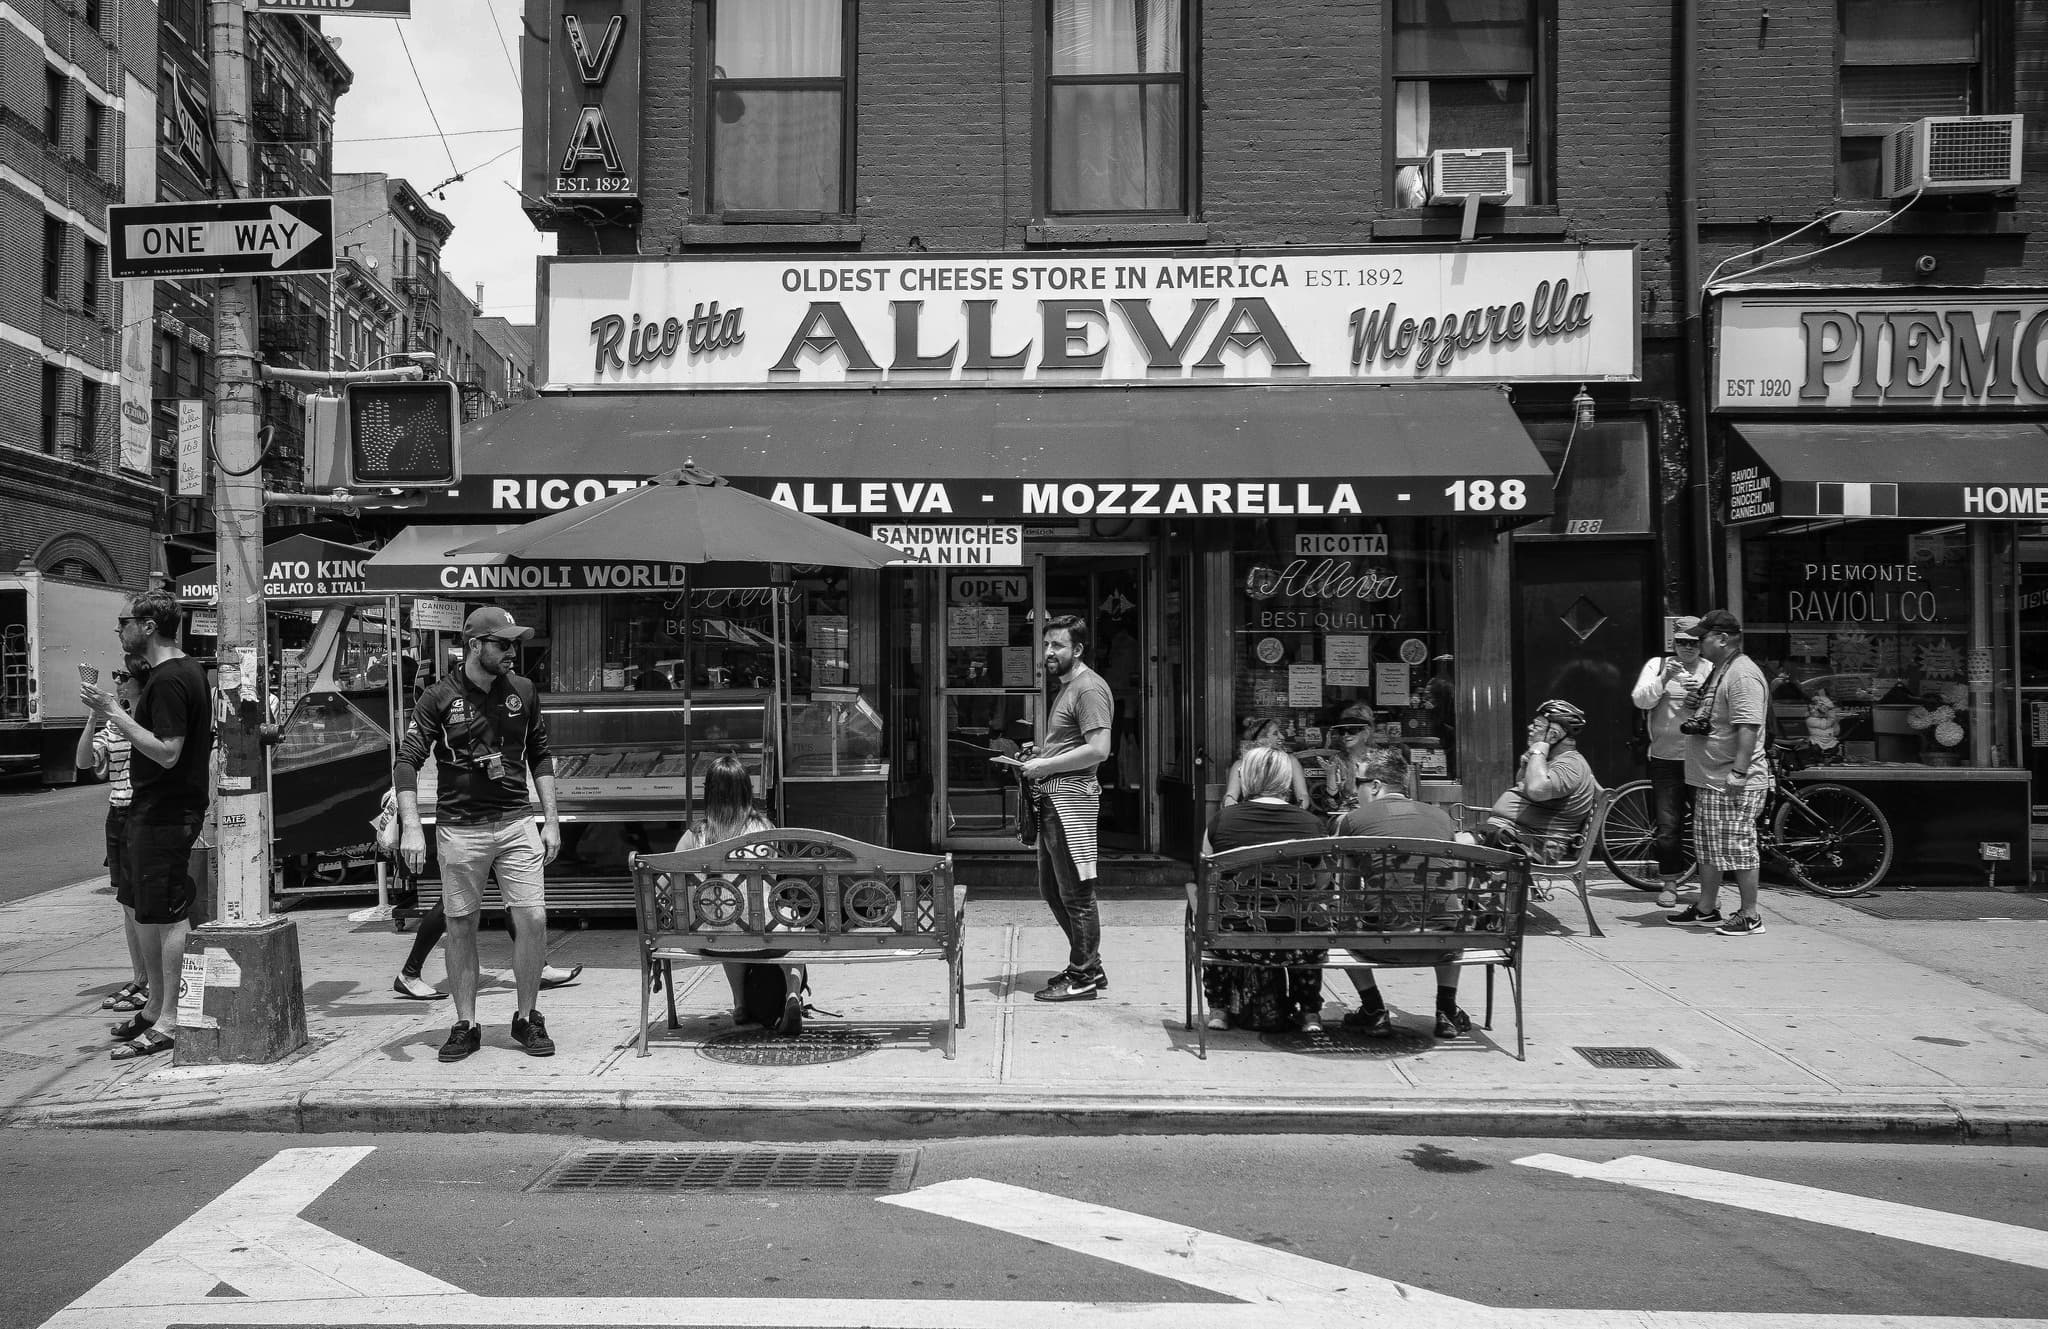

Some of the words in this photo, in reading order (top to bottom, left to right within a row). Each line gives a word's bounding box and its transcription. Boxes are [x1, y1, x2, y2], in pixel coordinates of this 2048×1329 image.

[556, 178, 591, 191] EST.
[597, 178, 630, 191] 1892
[143, 227, 205, 255] ONE
[235, 223, 299, 251] WAY
[782, 268, 891, 292] OLDEST
[899, 267, 1003, 291] CHEESE
[1011, 266, 1106, 291] STORE
[1115, 266, 1147, 289] IN
[1156, 264, 1289, 288] AMERICA
[1304, 270, 1351, 288] EST.
[1357, 268, 1404, 287] 1892
[1349, 277, 1593, 371] Mozzarella
[590, 300, 746, 375] Ricotta
[769, 297, 1311, 372] ALLEVA
[1727, 380, 1755, 398] EST
[1759, 379, 1792, 398] 1920
[182, 440, 199, 453] 163
[1731, 466, 1758, 483] RAVIOLI
[1731, 476, 1770, 495] TORTELLINI
[491, 479, 651, 511] RICOT
[769, 482, 953, 514] ALLEVA
[1022, 483, 1361, 514] MOZZARELLA
[1445, 480, 1526, 511] 188
[1731, 491, 1762, 507] GNOCCHI
[1731, 501, 1775, 520] CANNELLONI
[876, 527, 1018, 544] SANDWICHES
[1570, 520, 1600, 533] 188
[1300, 536, 1385, 552] RICOTTA
[903, 547, 991, 563] PANINI
[264, 561, 310, 580] ATO
[440, 566, 571, 588] CANNOLI
[583, 565, 685, 587] WORLD
[1261, 558, 1402, 599] Alleva
[1805, 564, 1918, 581] PIEMONTE
[264, 583, 314, 595] GELATO
[960, 580, 1019, 597] OPEN
[421, 602, 458, 610] CANNOLI
[1789, 591, 1889, 621] RAVIOLI
[1261, 611, 1305, 628] BEST
[1314, 611, 1400, 631] QUALITY
